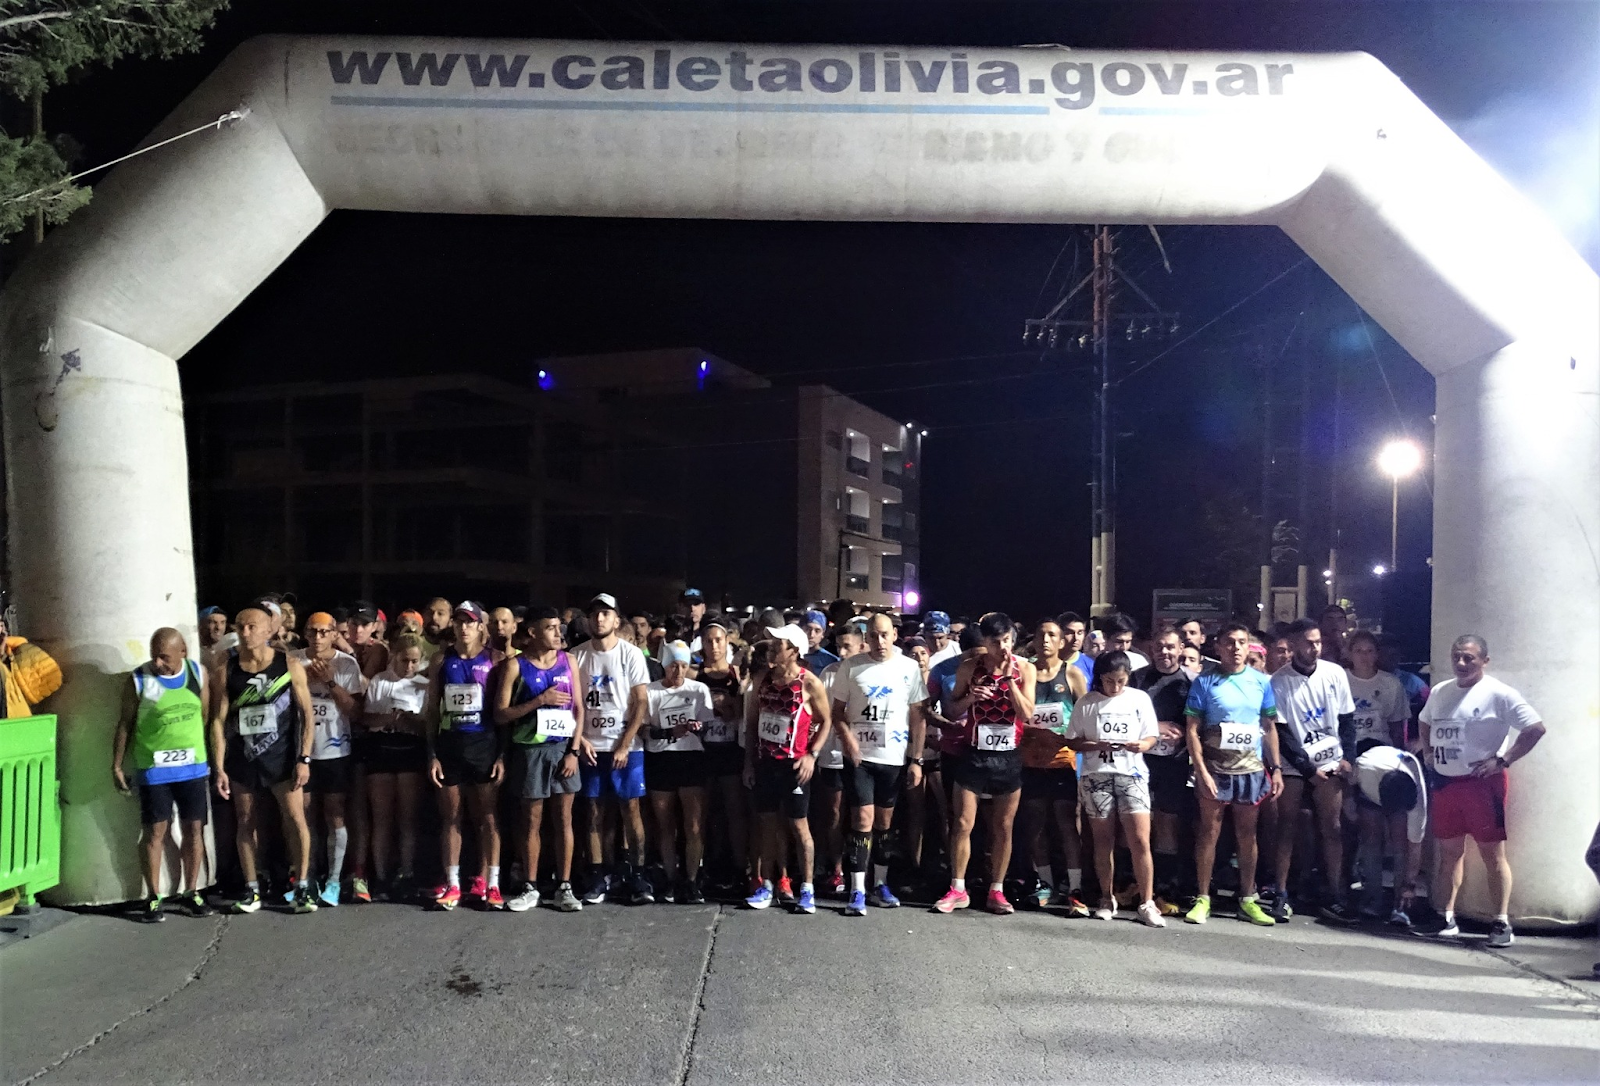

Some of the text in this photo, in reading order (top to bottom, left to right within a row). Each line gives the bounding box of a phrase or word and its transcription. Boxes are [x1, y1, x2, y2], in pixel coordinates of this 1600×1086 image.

[326, 49, 1294, 110] www.caletaolivia.gov.ar
[451, 693, 473, 705] 123
[585, 690, 601, 707] 41
[312, 704, 327, 717] 58
[861, 704, 878, 721] 41
[243, 714, 265, 728] 167
[591, 716, 616, 728] 029
[665, 713, 687, 726] 156
[1033, 711, 1058, 725] 246
[545, 719, 566, 731] 124
[761, 721, 781, 736] 140
[1102, 722, 1129, 735] 043
[857, 731, 878, 742] 114
[1226, 732, 1253, 745] 268
[1435, 727, 1460, 739] 001
[985, 734, 1010, 747] 074
[162, 749, 188, 763] 223
[1314, 747, 1334, 762] 033
[1434, 746, 1448, 765] 41
